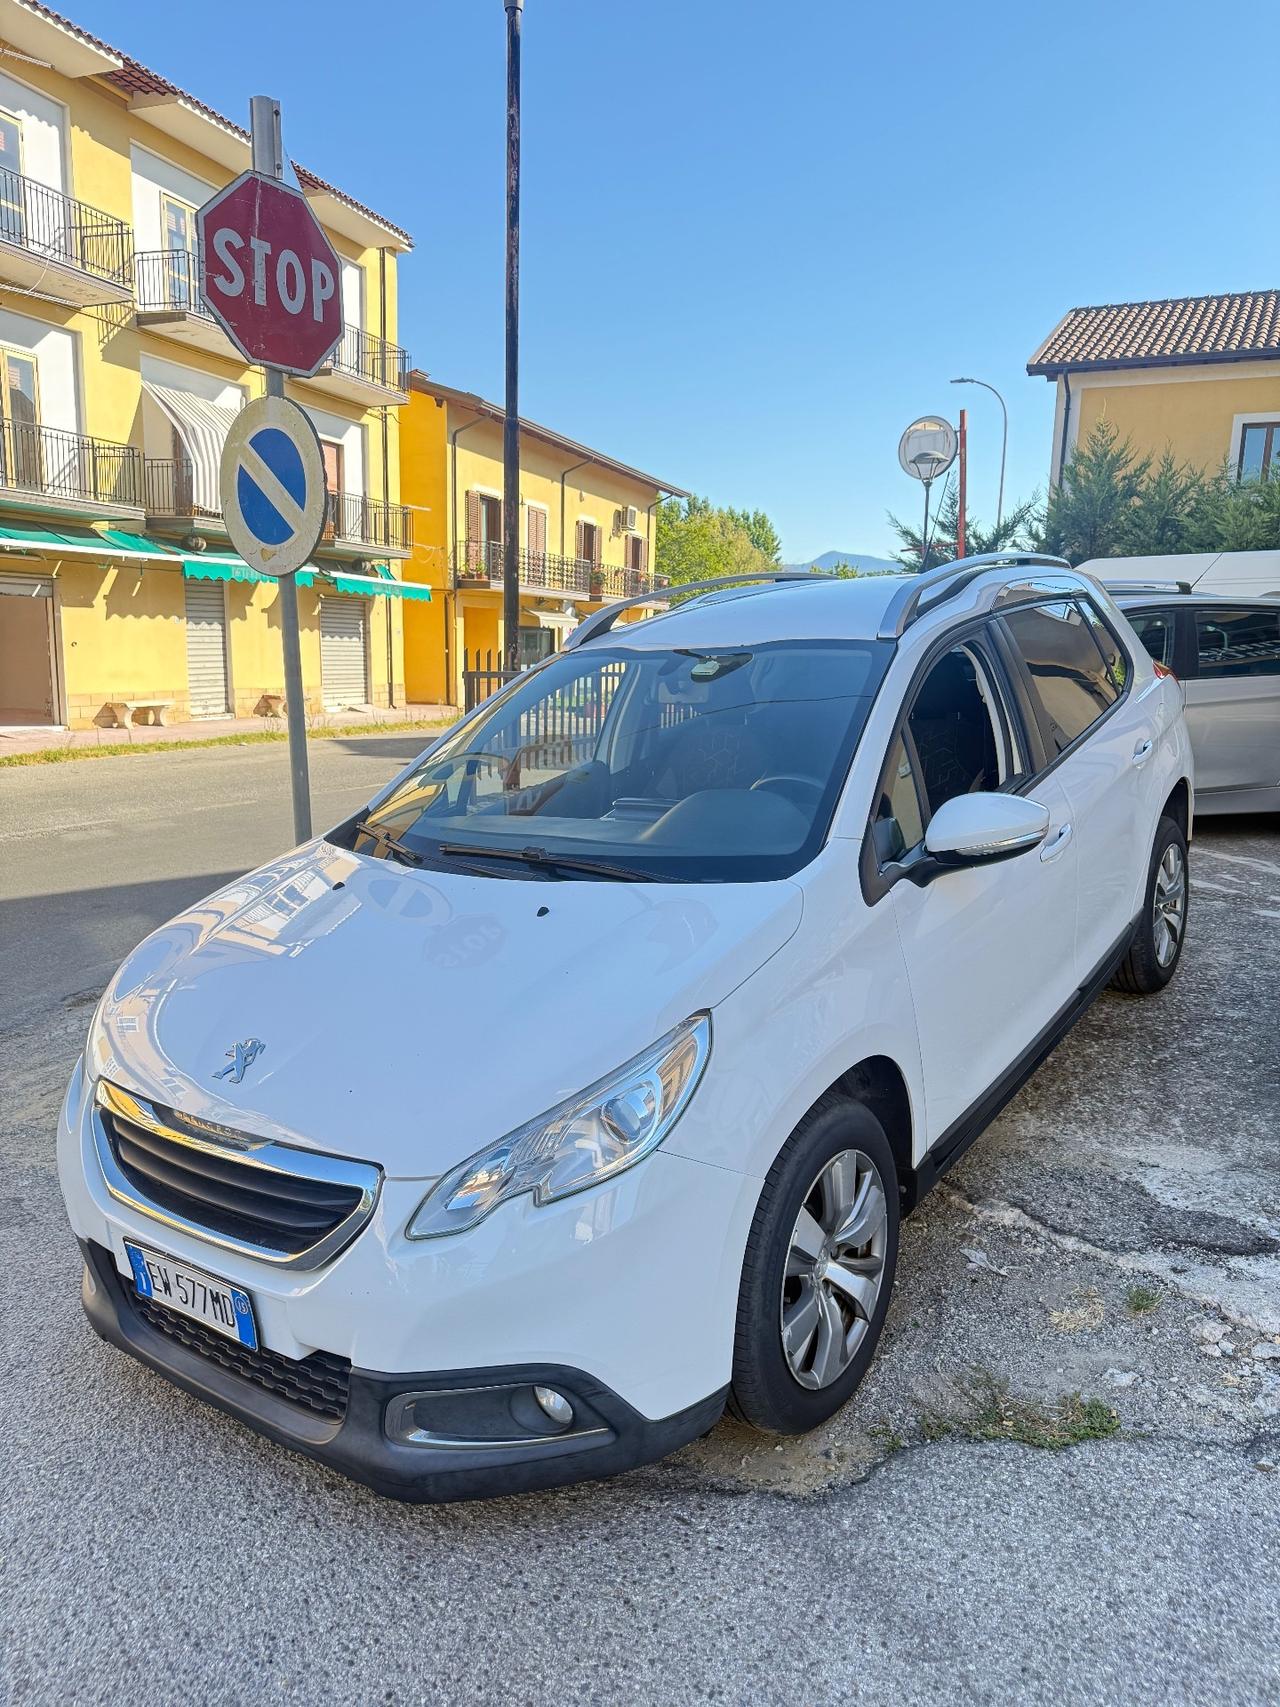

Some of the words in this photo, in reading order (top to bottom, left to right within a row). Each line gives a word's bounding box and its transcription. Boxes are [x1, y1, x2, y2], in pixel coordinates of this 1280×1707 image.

[213, 227, 335, 323] STOP
[146, 1260, 172, 1298] EW
[176, 1272, 236, 1328] 577MD
